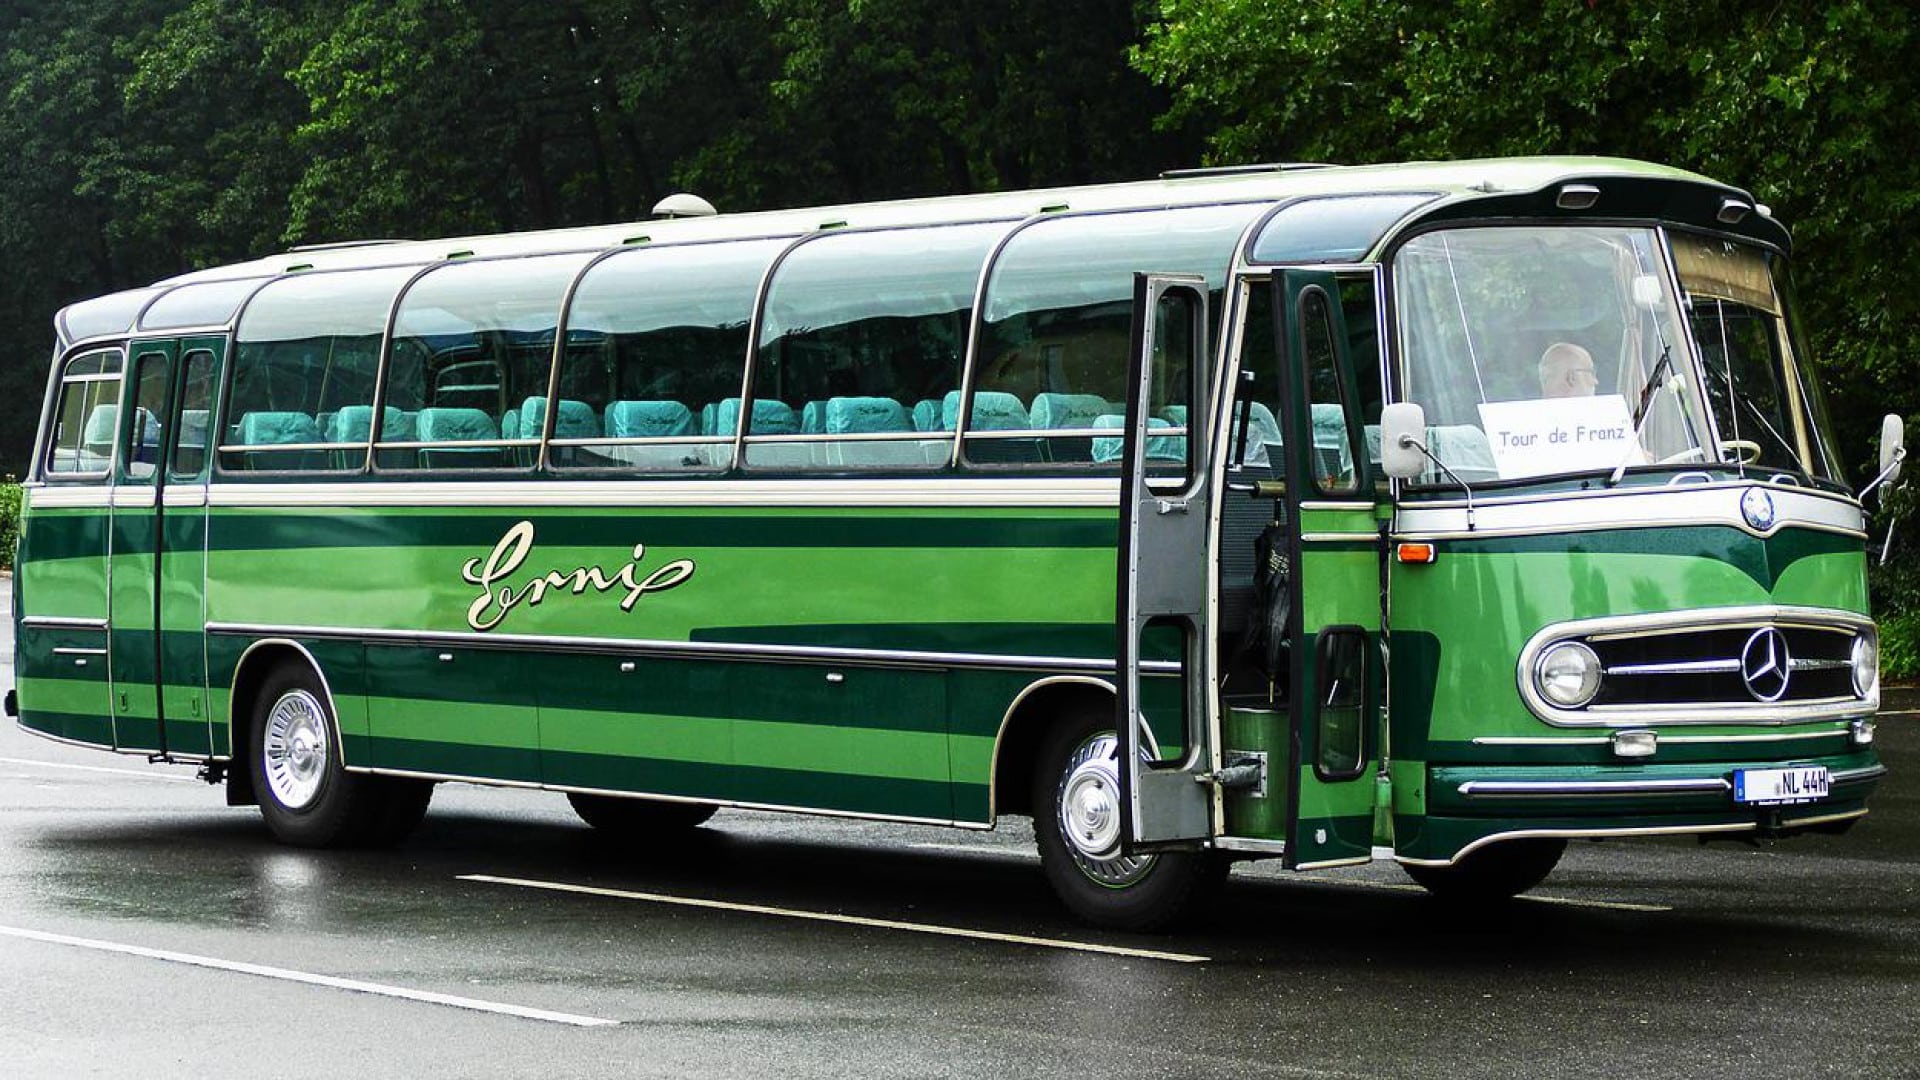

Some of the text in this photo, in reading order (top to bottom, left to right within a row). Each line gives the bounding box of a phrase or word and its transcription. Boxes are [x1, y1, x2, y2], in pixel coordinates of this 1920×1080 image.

[1548, 427, 1568, 443] de
[1782, 769, 1827, 794] NL 44H
